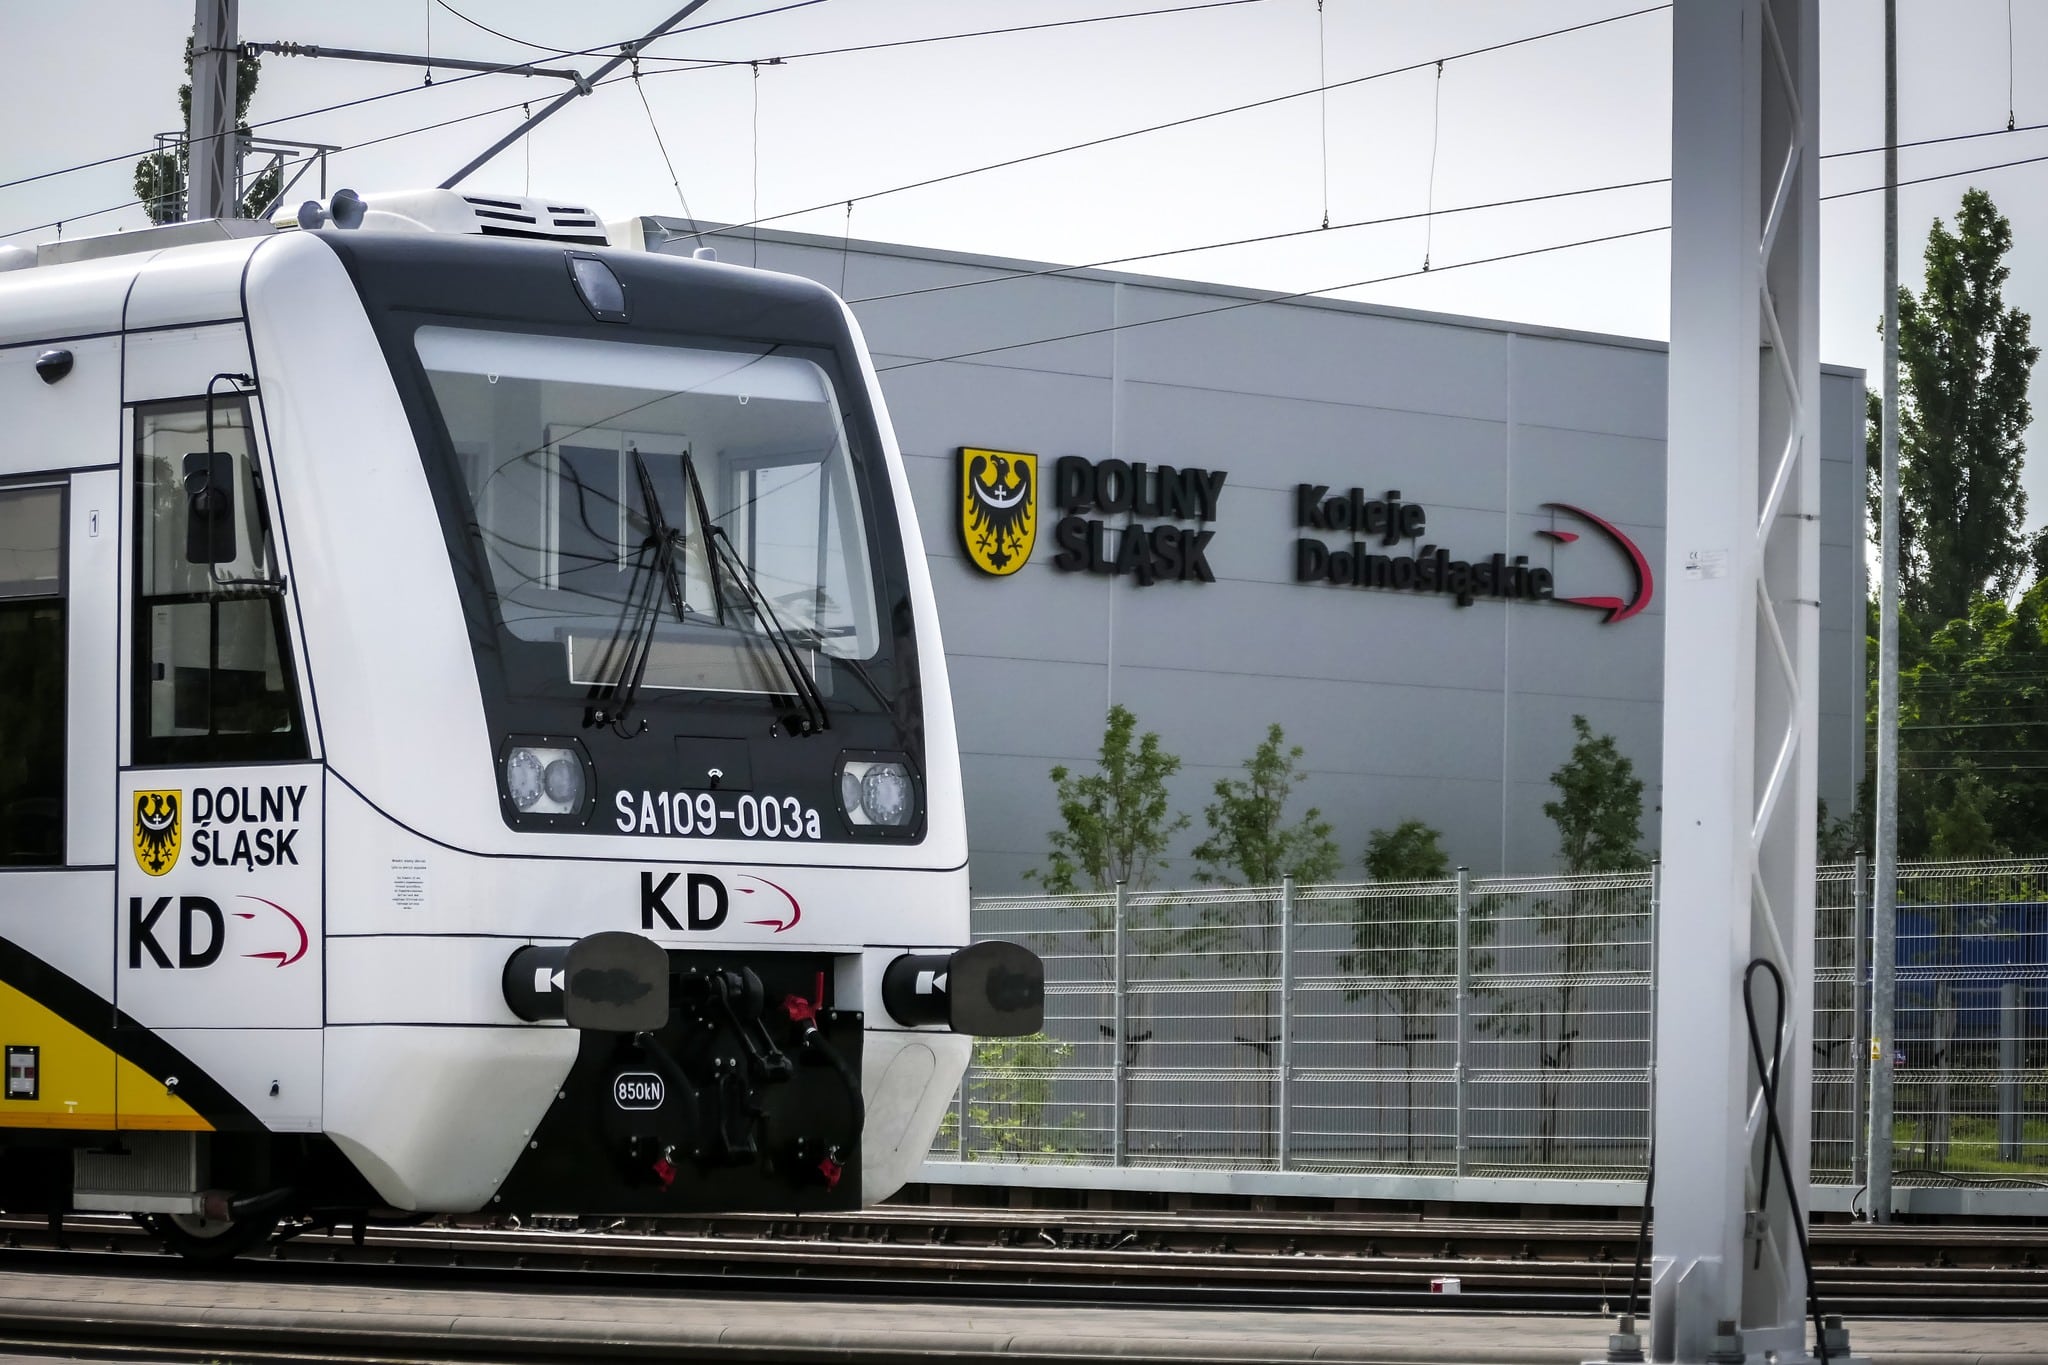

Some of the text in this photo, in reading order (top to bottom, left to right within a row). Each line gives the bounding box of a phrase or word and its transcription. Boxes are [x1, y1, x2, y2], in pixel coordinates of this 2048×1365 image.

[1056, 455, 1228, 522] DOLNY
[1298, 484, 1425, 546] Koleje
[1054, 506, 1216, 587] ŚLĄSK
[1298, 538, 1553, 607] Dolnośląskie
[192, 785, 308, 824] DOLNY
[615, 790, 822, 839] SA109-003a
[190, 821, 299, 872] ŚLĄSK
[640, 871, 730, 931] KD
[129, 895, 226, 969] KD
[618, 1082, 660, 1100] 850kN
